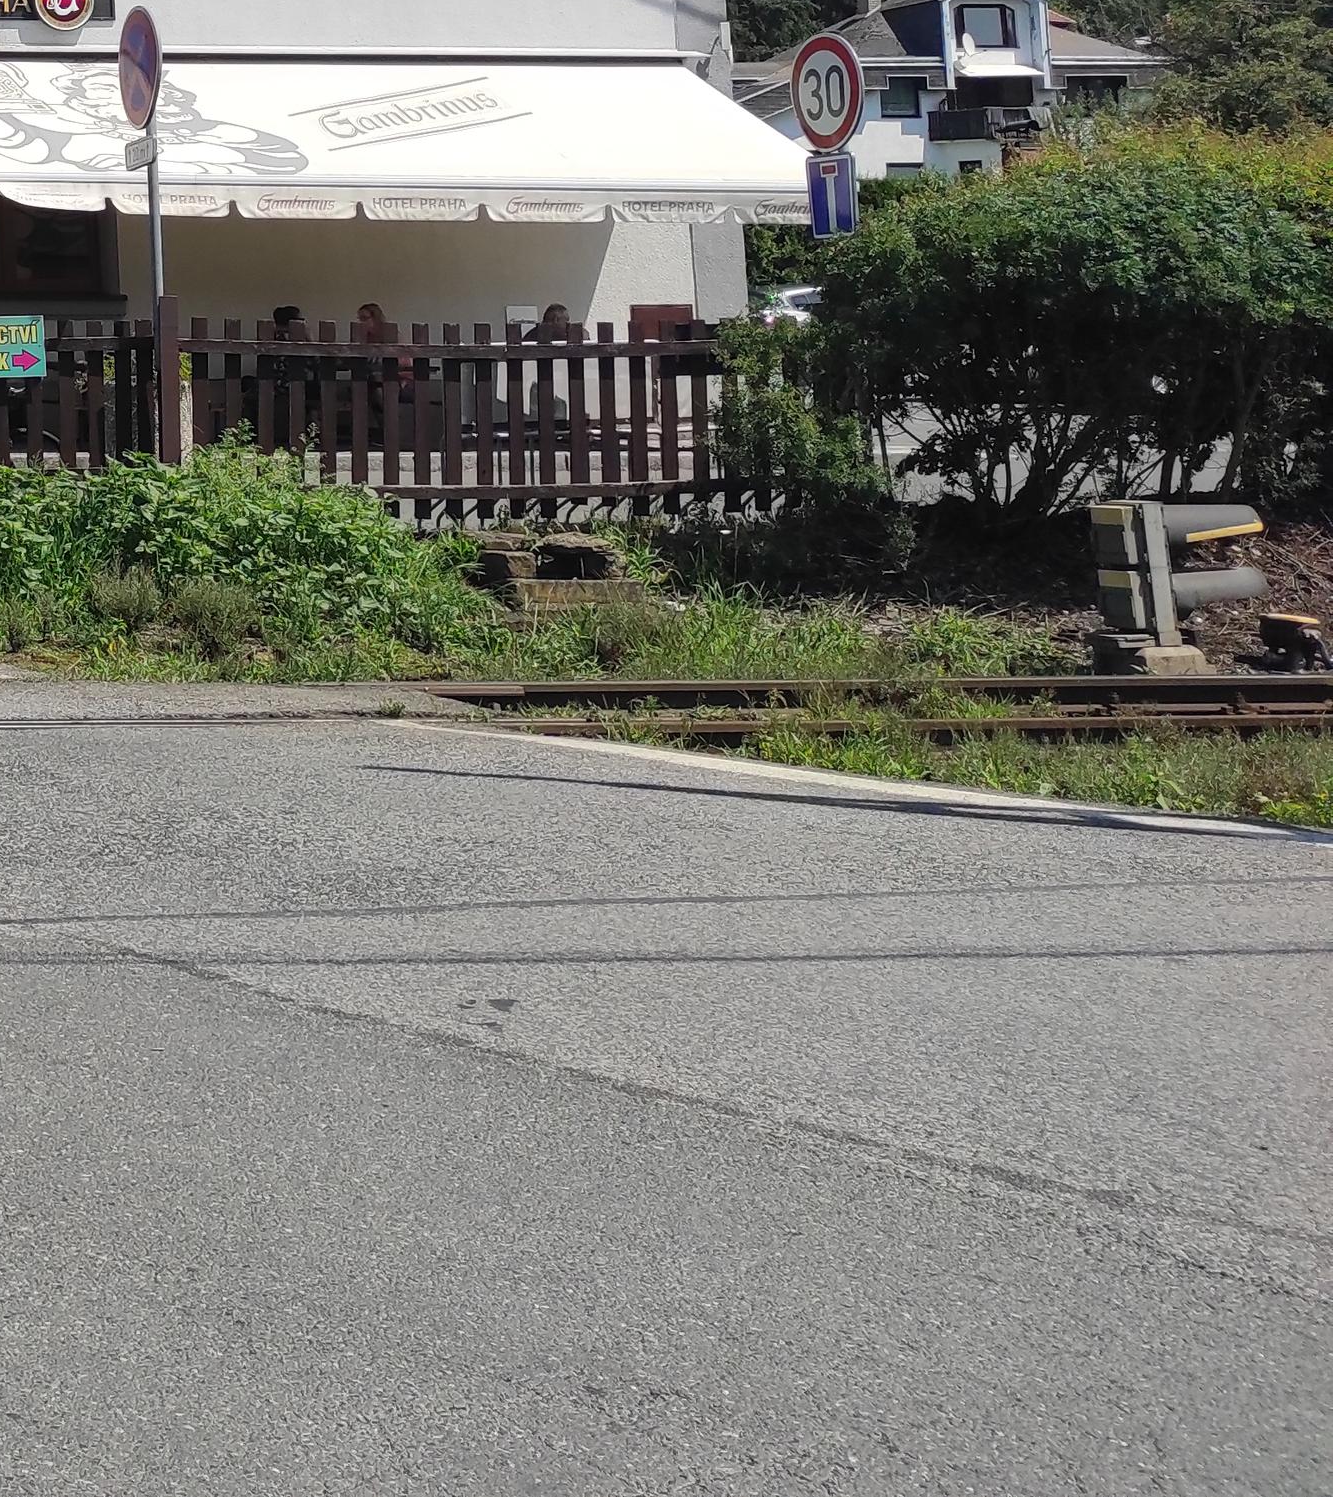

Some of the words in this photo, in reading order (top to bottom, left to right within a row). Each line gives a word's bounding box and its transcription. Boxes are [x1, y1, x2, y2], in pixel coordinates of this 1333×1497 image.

[319, 92, 498, 139] Gambrinus
[803, 64, 845, 121] 30
[170, 194, 218, 206] PRAHA
[257, 193, 335, 212] Gambrinus
[372, 197, 416, 210] HOTEL
[420, 198, 467, 210] PRAHA
[506, 196, 583, 215] Gambrinus
[622, 200, 664, 212] HOTEL
[668, 201, 715, 214] PRAHA
